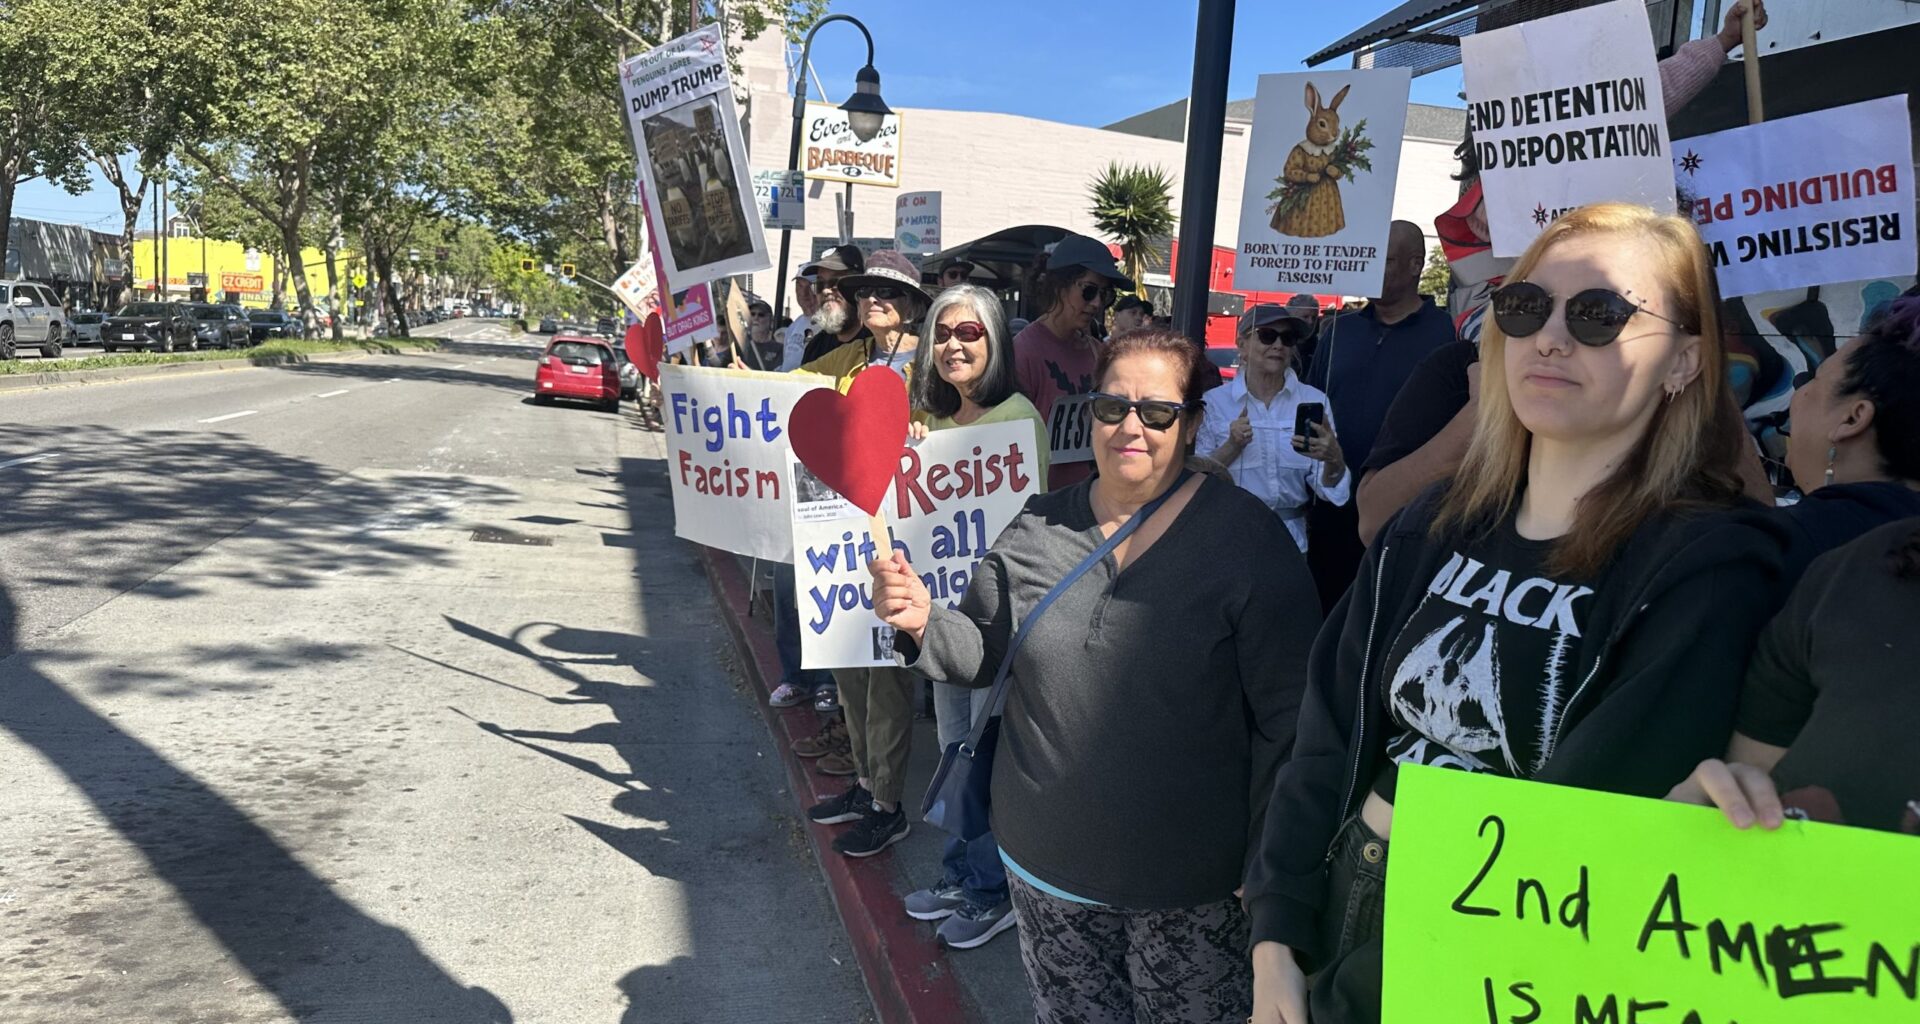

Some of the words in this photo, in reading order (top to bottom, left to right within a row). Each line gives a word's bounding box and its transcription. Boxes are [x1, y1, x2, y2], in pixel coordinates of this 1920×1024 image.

[632, 67, 667, 87] PENGUINS
[669, 56, 691, 73] AGREE
[648, 52, 663, 65] OUT
[666, 47, 676, 58] OF
[631, 84, 670, 113] DUMP
[671, 63, 723, 96] TRUMP
[1468, 99, 1506, 132] END
[1511, 77, 1647, 128] DETENTION
[807, 146, 895, 179] BARBEQUE
[1501, 123, 1661, 169] DEPORTATION
[755, 186, 769, 196] 72
[913, 197, 926, 206] ON
[1741, 164, 1898, 216] BUILDING
[911, 216, 938, 226] WATER
[1737, 213, 1901, 262] RESISTING
[1244, 243, 1279, 254] BORN
[1282, 244, 1300, 255] TO
[1303, 245, 1320, 256] BE
[1323, 245, 1376, 258] TENDER
[1250, 257, 1300, 269] FORCED
[1303, 259, 1322, 270] TO
[1325, 260, 1369, 272] FIGHT
[223, 277, 234, 286] EZ
[1278, 272, 1333, 284] FASCISM
[671, 393, 782, 452] Fight
[679, 450, 780, 499] Facism
[895, 443, 1030, 519] Resist
[806, 526, 913, 575] with
[931, 508, 989, 560] all
[1426, 550, 1594, 638] BLACK
[1451, 815, 1590, 943] 2nd
